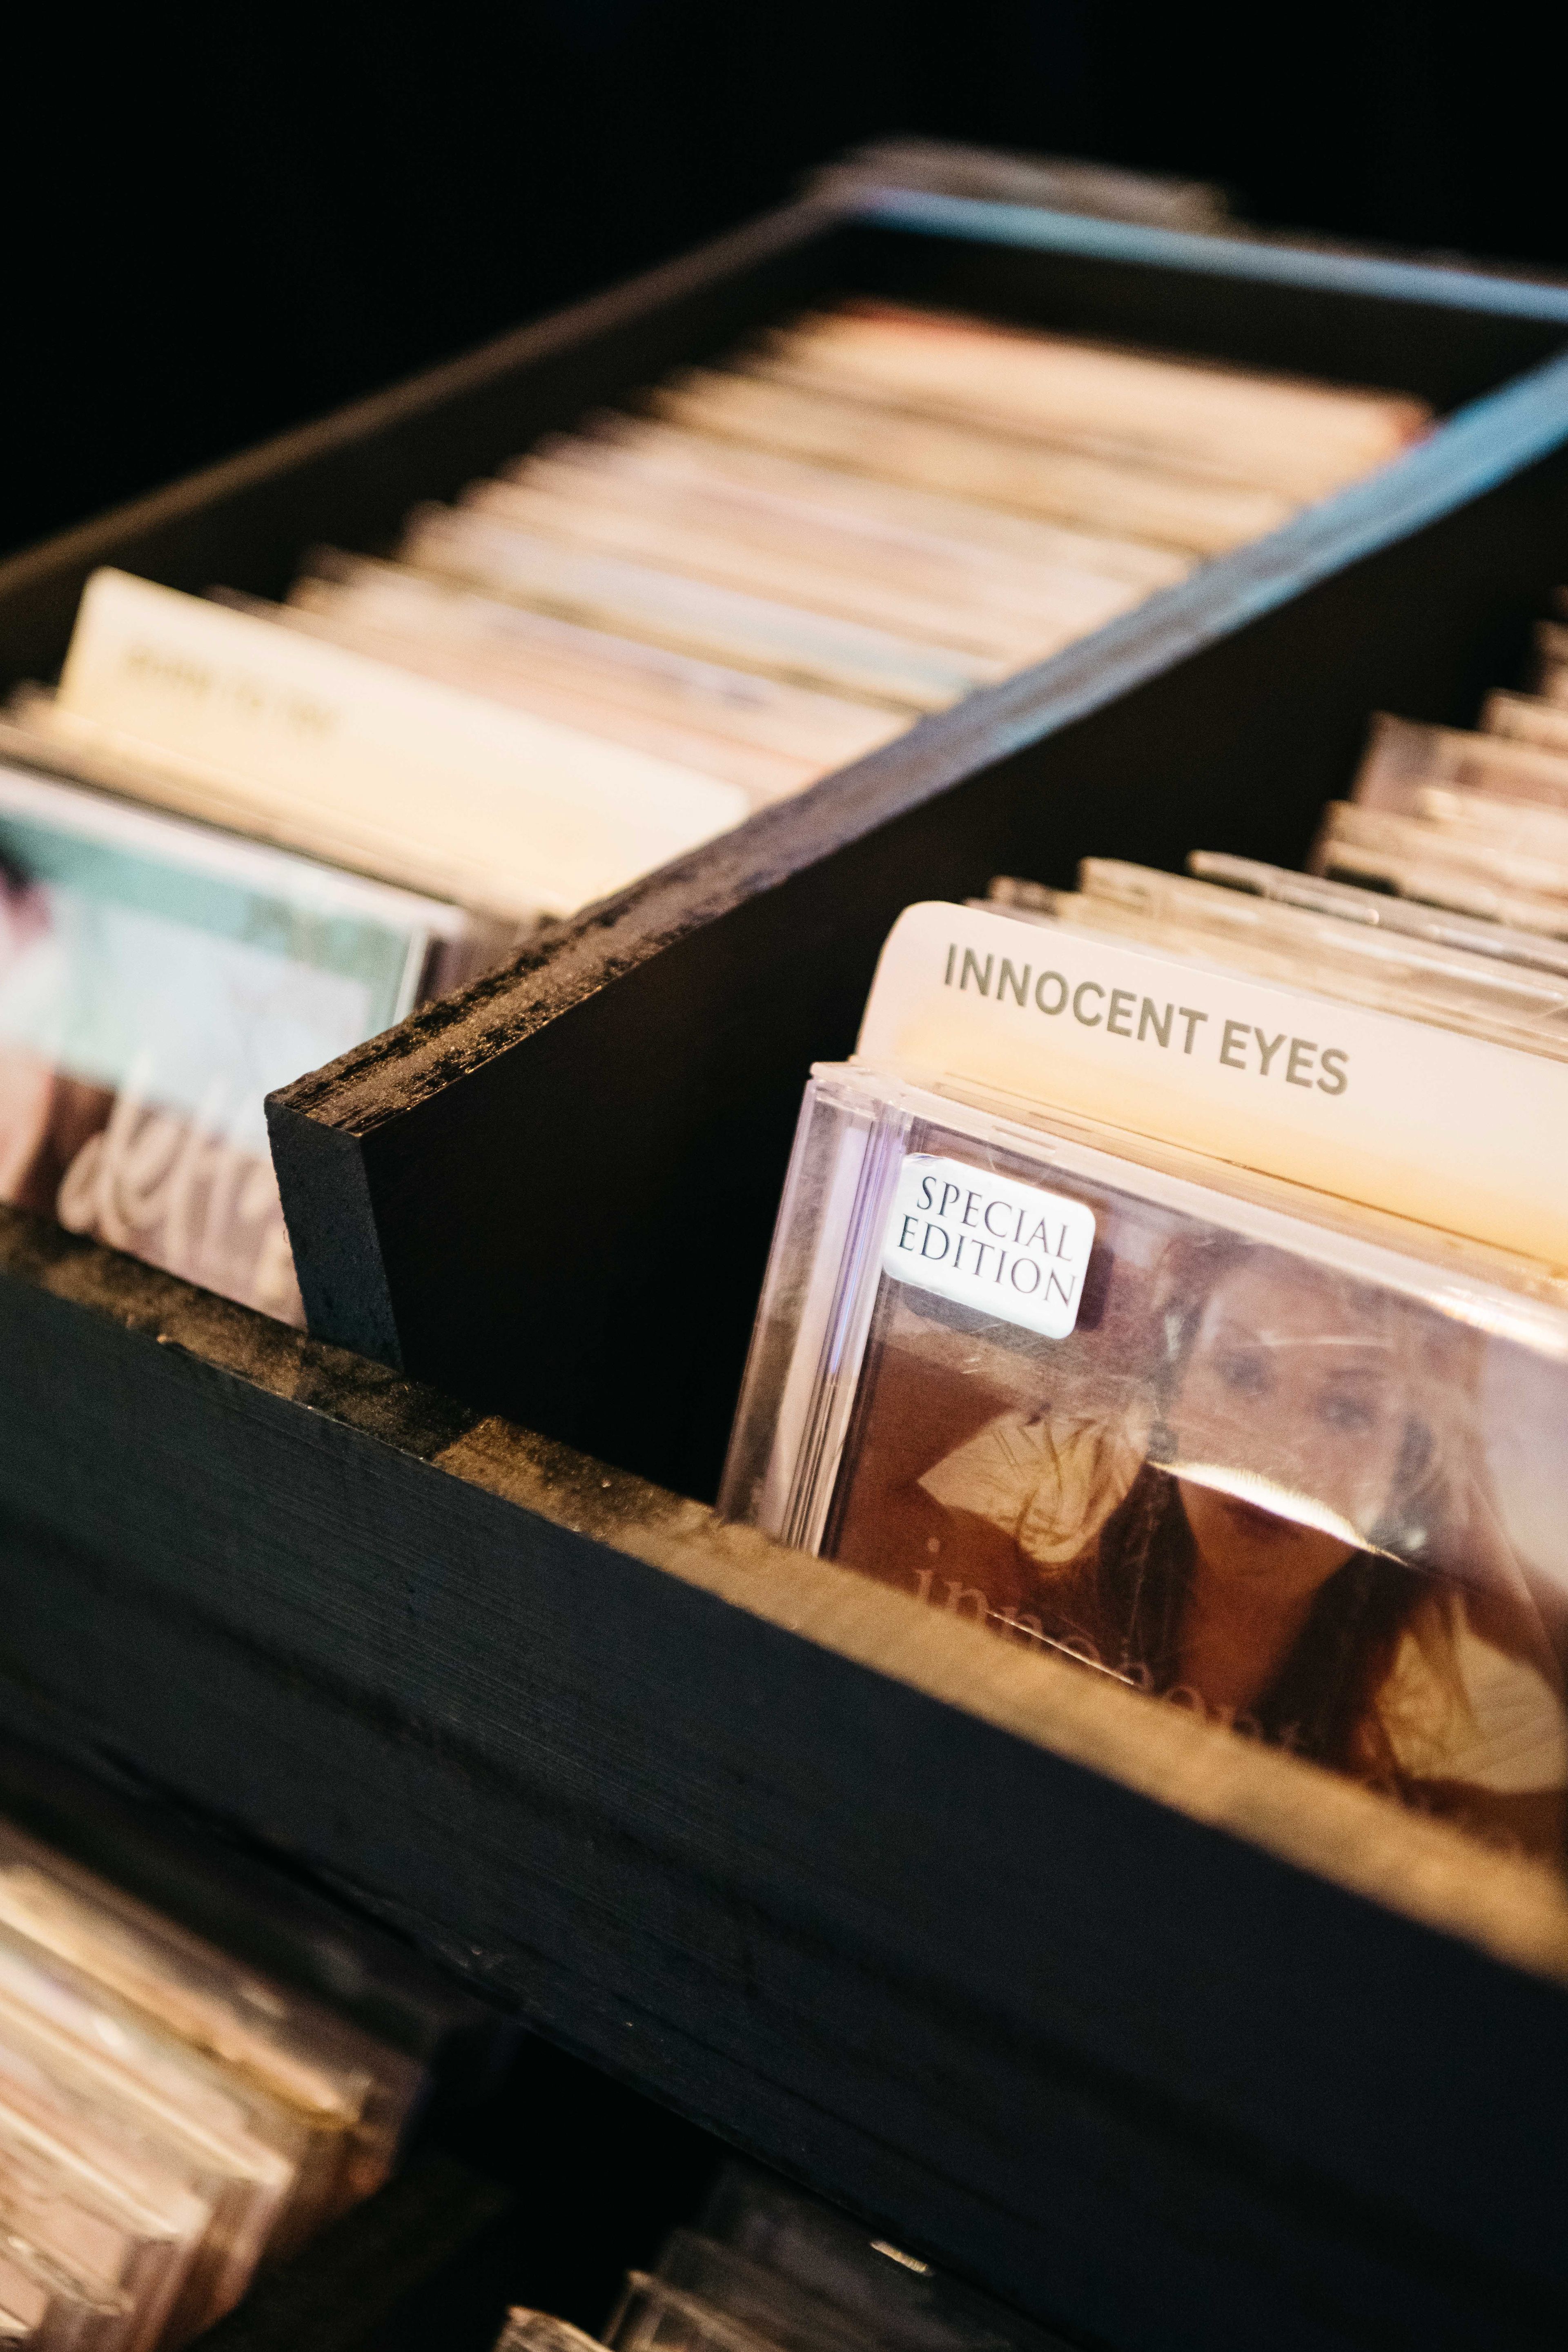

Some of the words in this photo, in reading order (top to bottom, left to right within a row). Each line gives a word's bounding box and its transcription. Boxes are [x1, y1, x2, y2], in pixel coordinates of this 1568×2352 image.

[944, 942, 1208, 1054] INNOCENT
[1219, 1019, 1351, 1096] EYES
[897, 1214, 1078, 1309] EDITION
[916, 1176, 1073, 1262] SPECIAL
